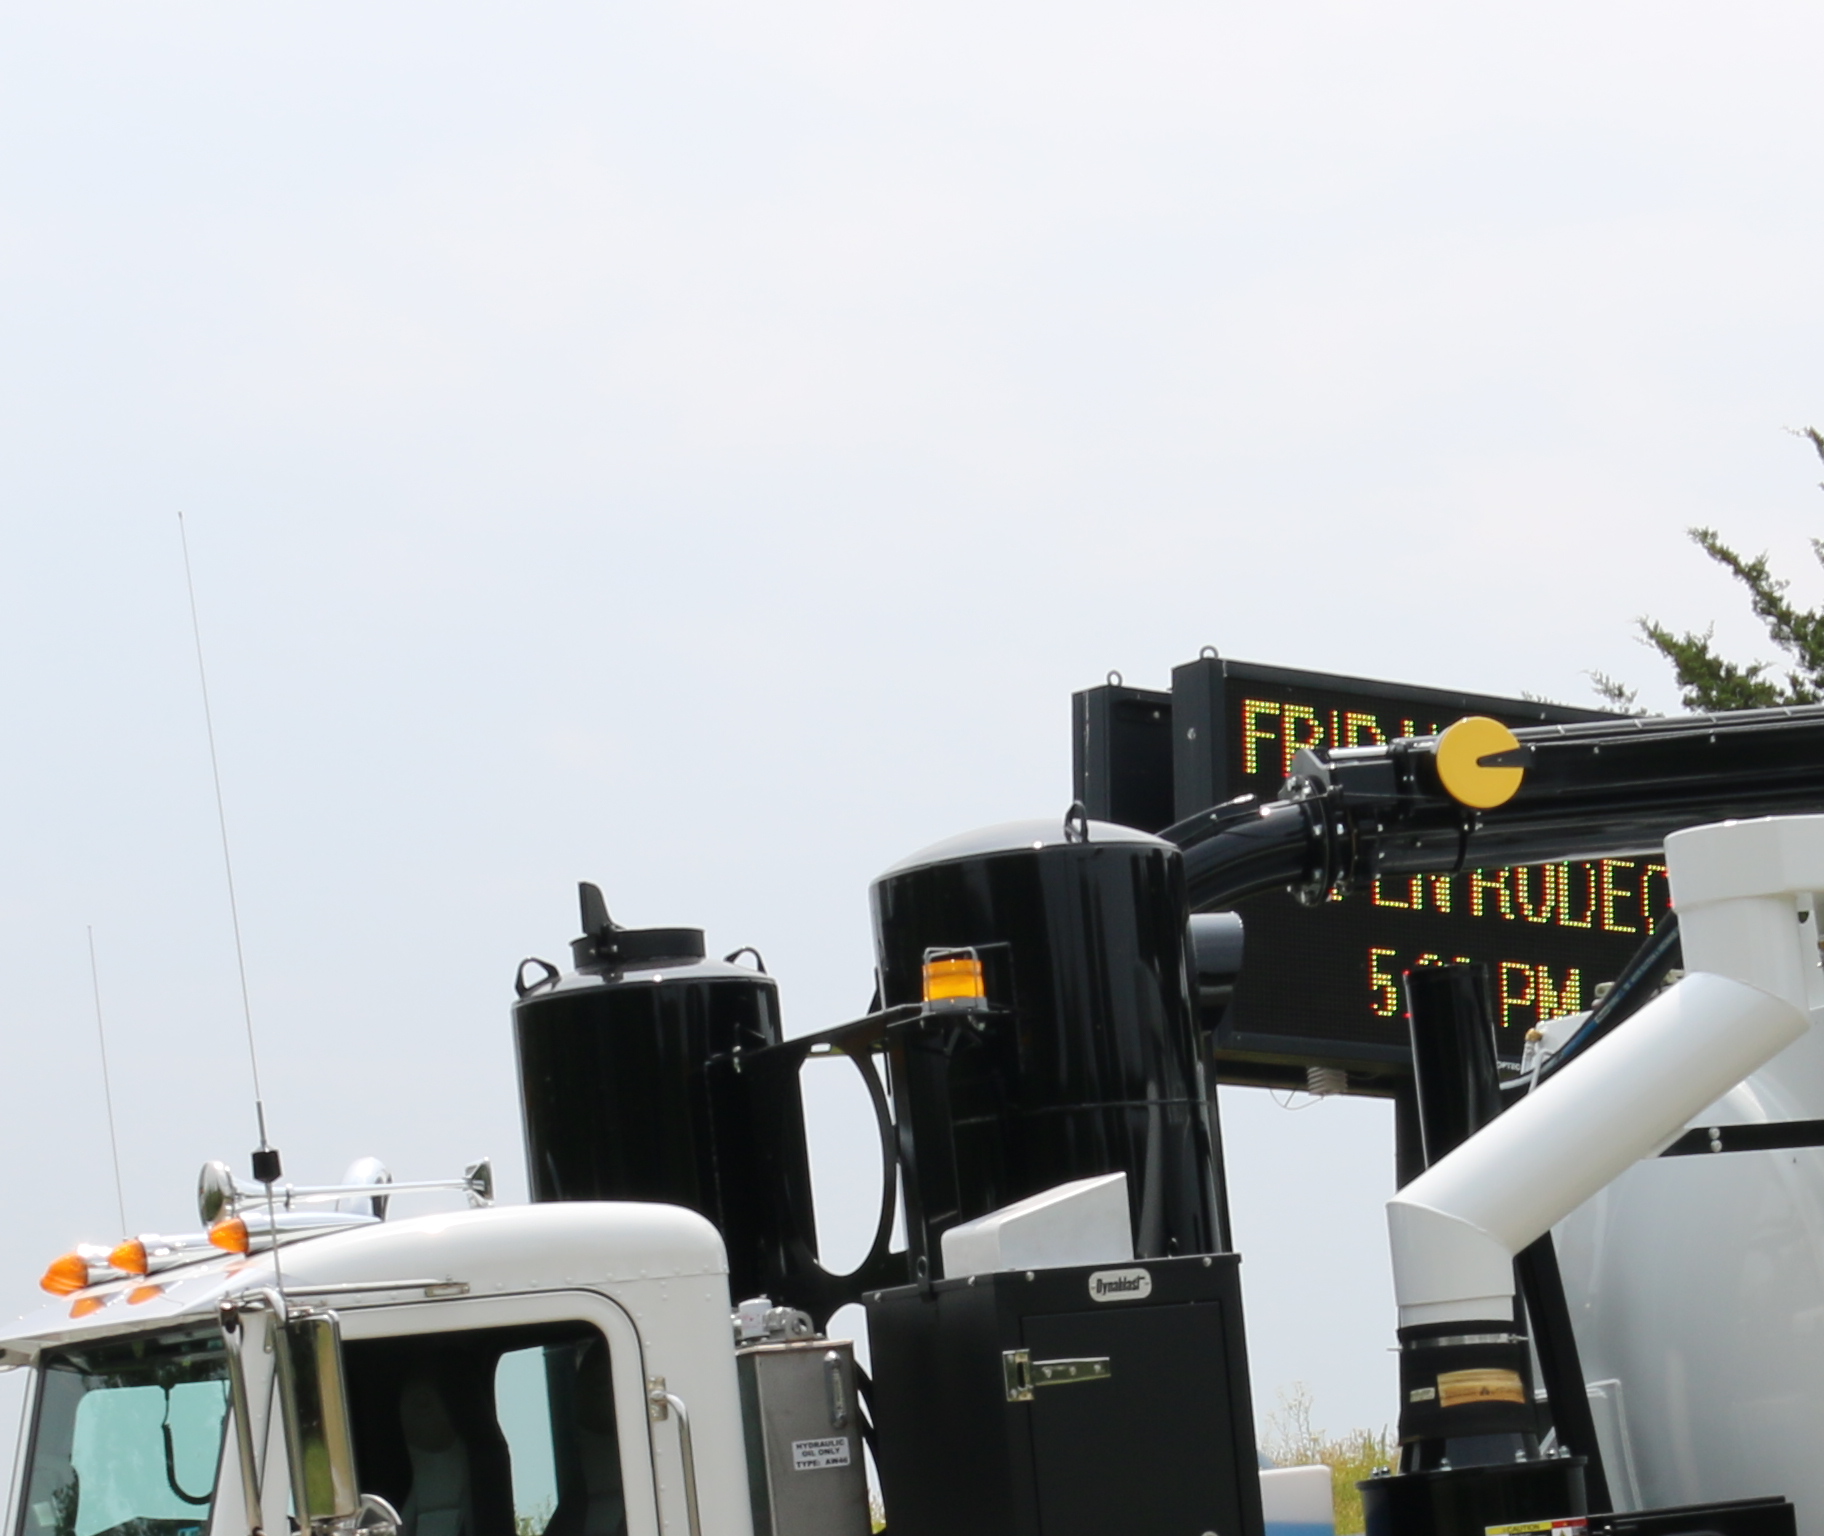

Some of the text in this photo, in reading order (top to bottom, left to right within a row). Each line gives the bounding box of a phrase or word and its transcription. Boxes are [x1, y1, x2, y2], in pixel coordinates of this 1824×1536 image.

[1500, 961, 1581, 1028] PM
[796, 1439, 845, 1449] HYDRAULIC
[818, 1447, 840, 1456] ONLY
